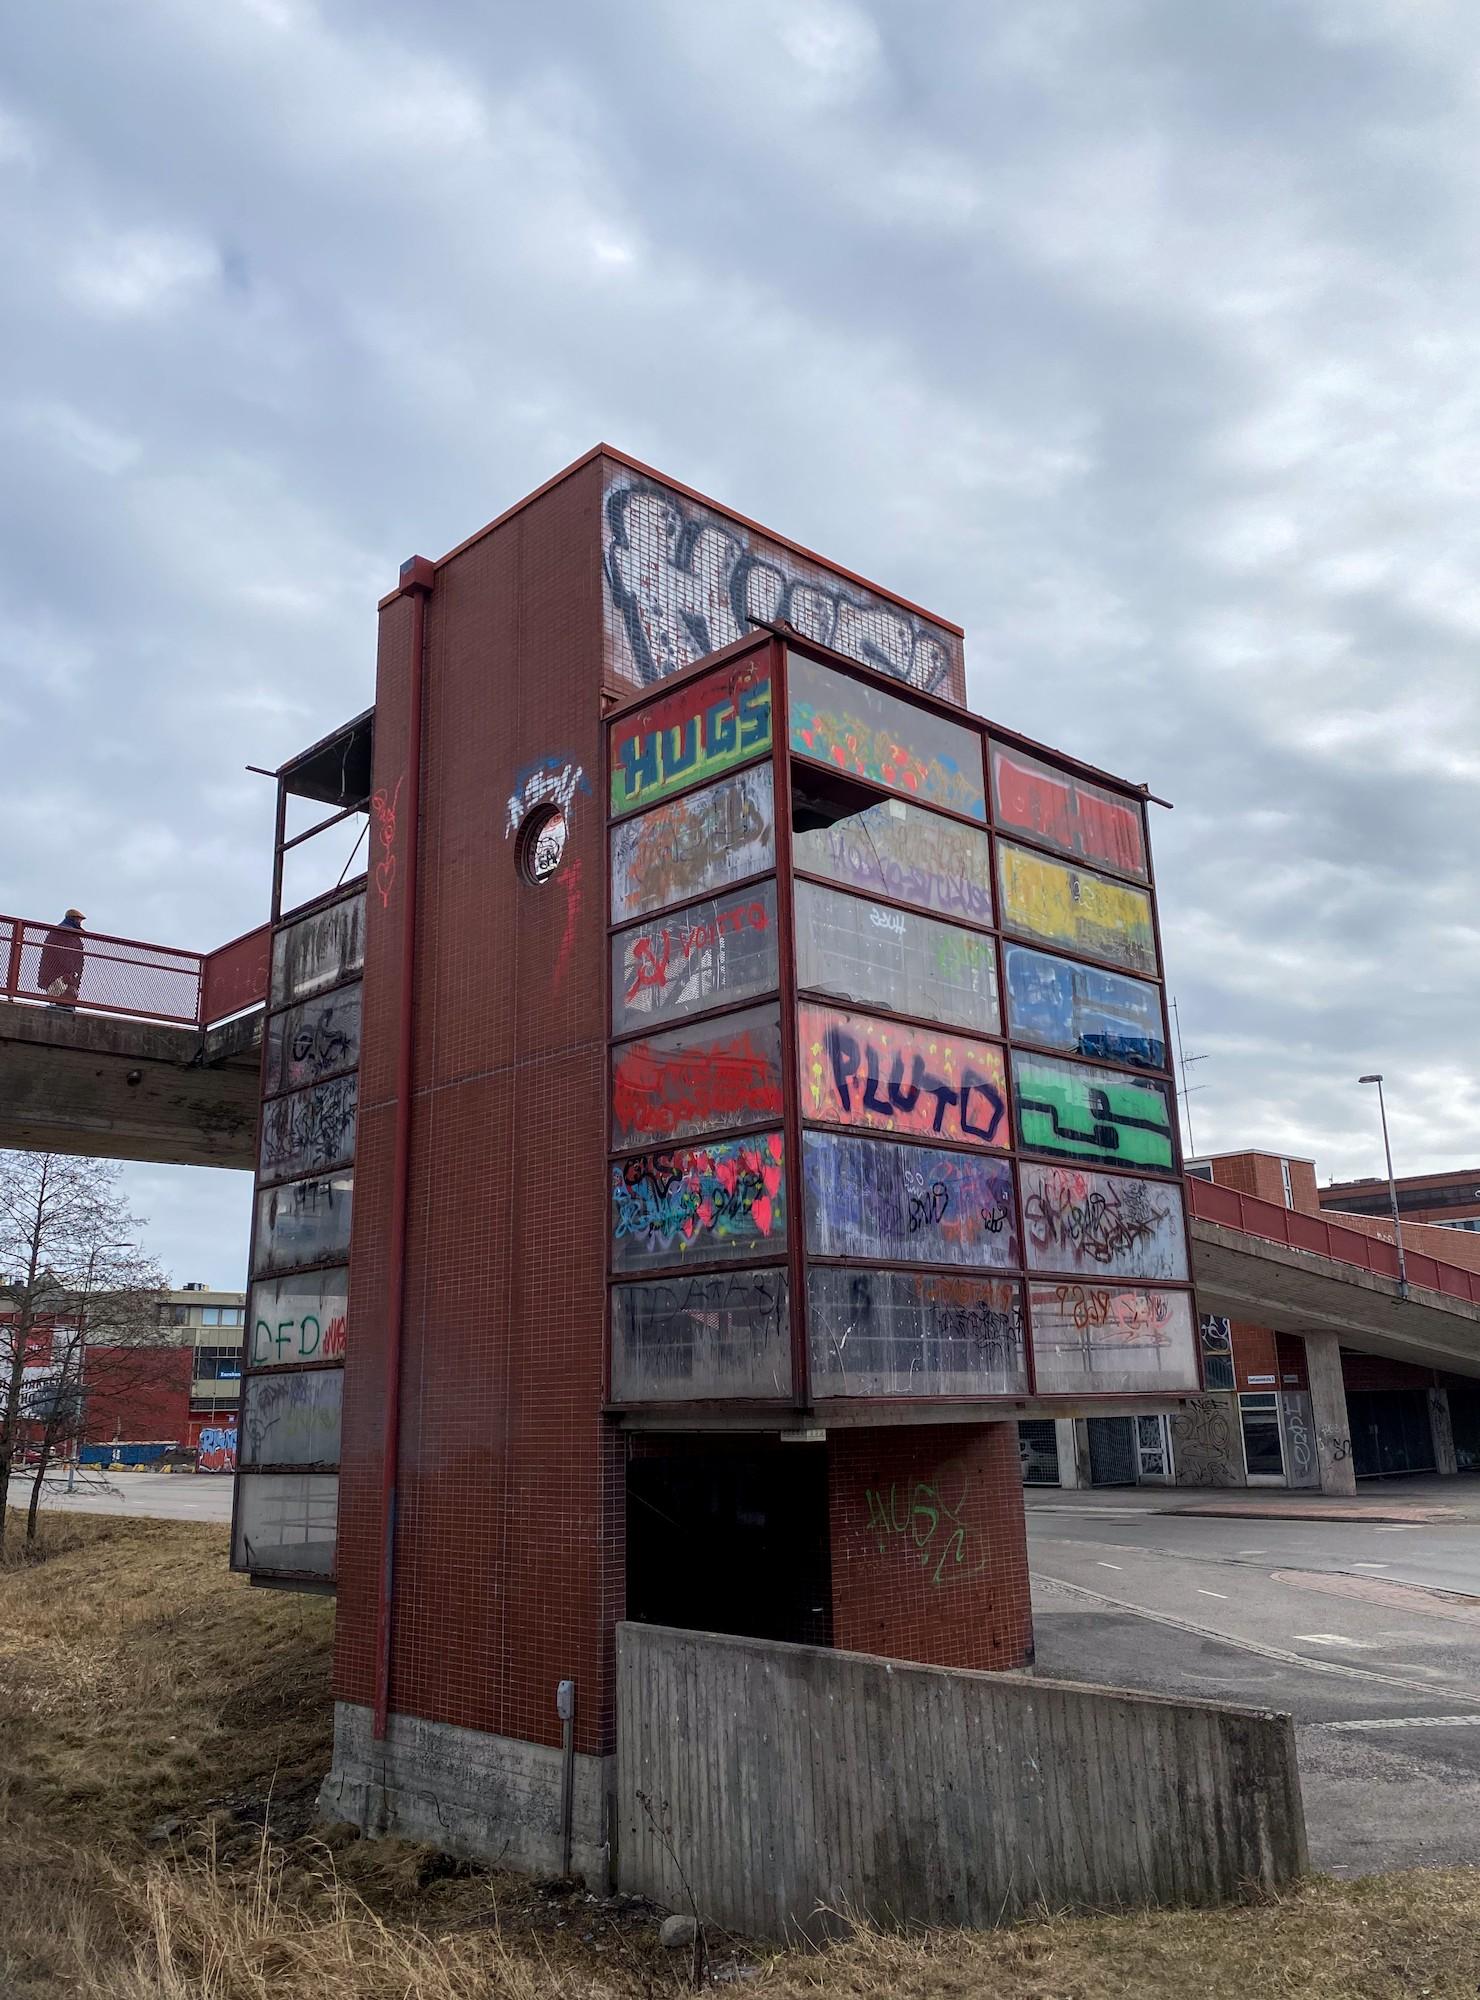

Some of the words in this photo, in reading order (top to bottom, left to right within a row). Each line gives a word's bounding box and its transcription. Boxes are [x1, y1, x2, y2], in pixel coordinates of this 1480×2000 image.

[621, 678, 772, 800] HUGS
[824, 1022, 1006, 1142] PLUTO
[254, 1315, 320, 1363] DFD
